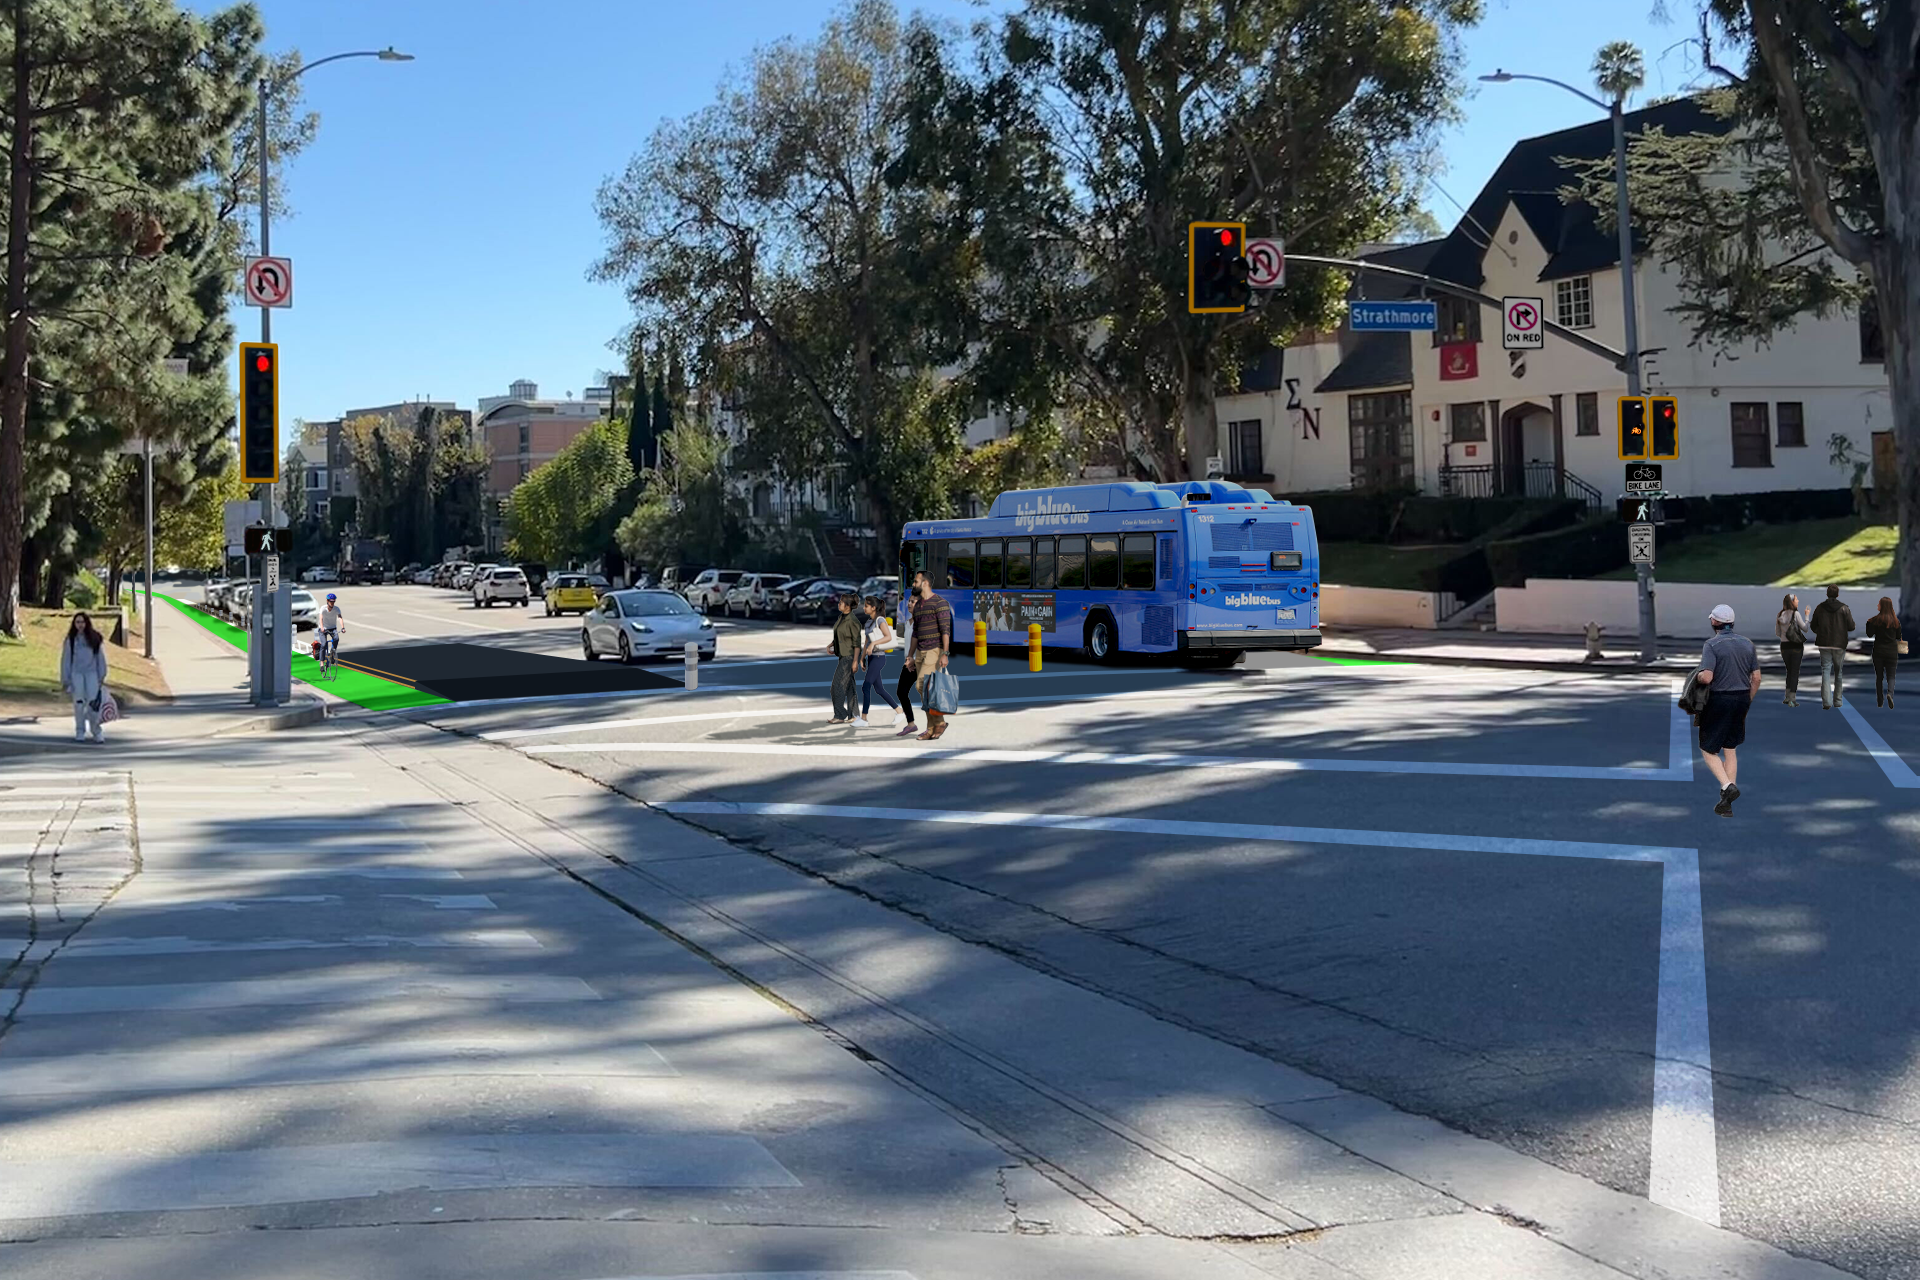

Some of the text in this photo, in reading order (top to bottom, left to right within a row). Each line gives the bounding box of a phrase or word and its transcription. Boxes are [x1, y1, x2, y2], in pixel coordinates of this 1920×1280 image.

[1353, 308, 1434, 324] Strathmore
[1507, 333, 1541, 342] ON RED
[1628, 482, 1642, 490] BIKE
[1198, 515, 1215, 523] 1312
[1020, 606, 1035, 617] PAIN
[1038, 606, 1053, 617] GAIN
